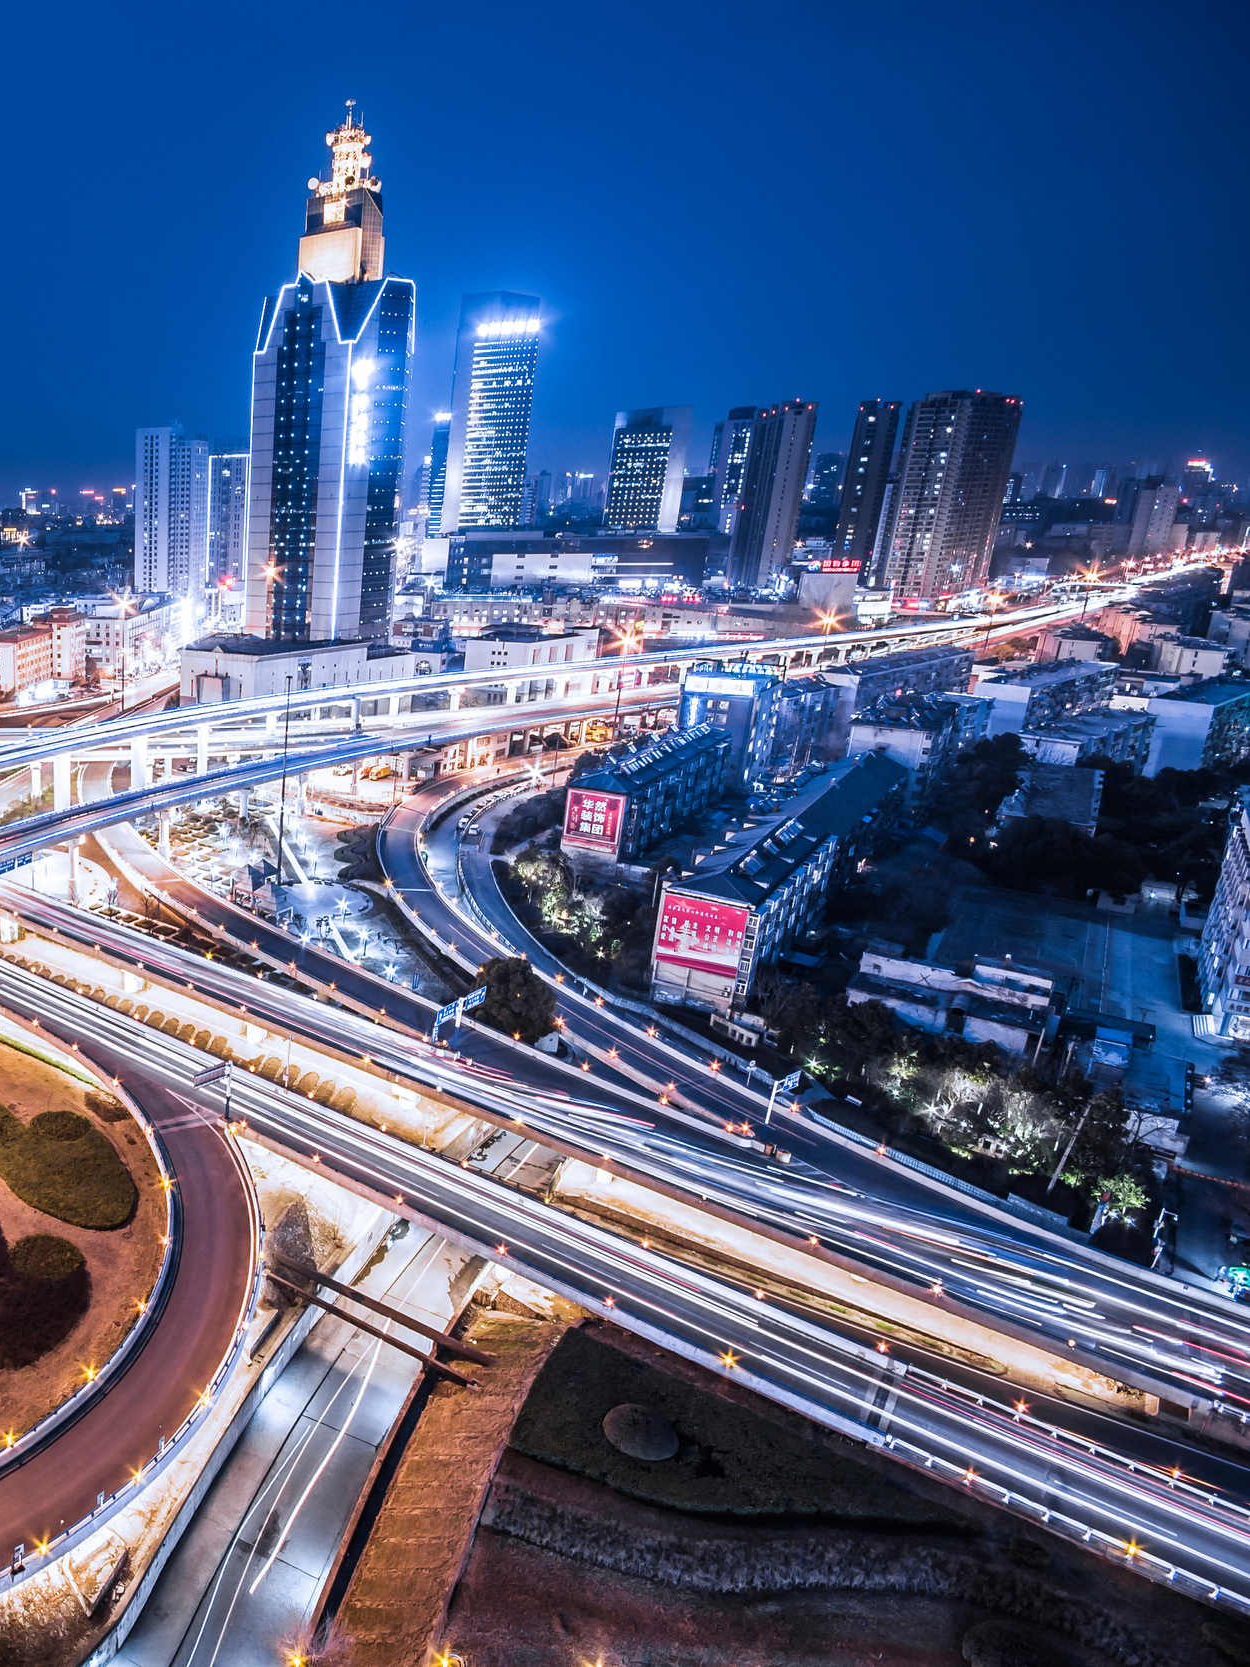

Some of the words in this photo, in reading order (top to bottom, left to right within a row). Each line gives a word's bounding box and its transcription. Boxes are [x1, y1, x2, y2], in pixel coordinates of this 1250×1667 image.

[582, 799, 607, 812] 华然
[580, 810, 605, 823] 装饰
[579, 821, 604, 835] 集团
[706, 925, 720, 934] 文明
[704, 934, 719, 943] 公正
